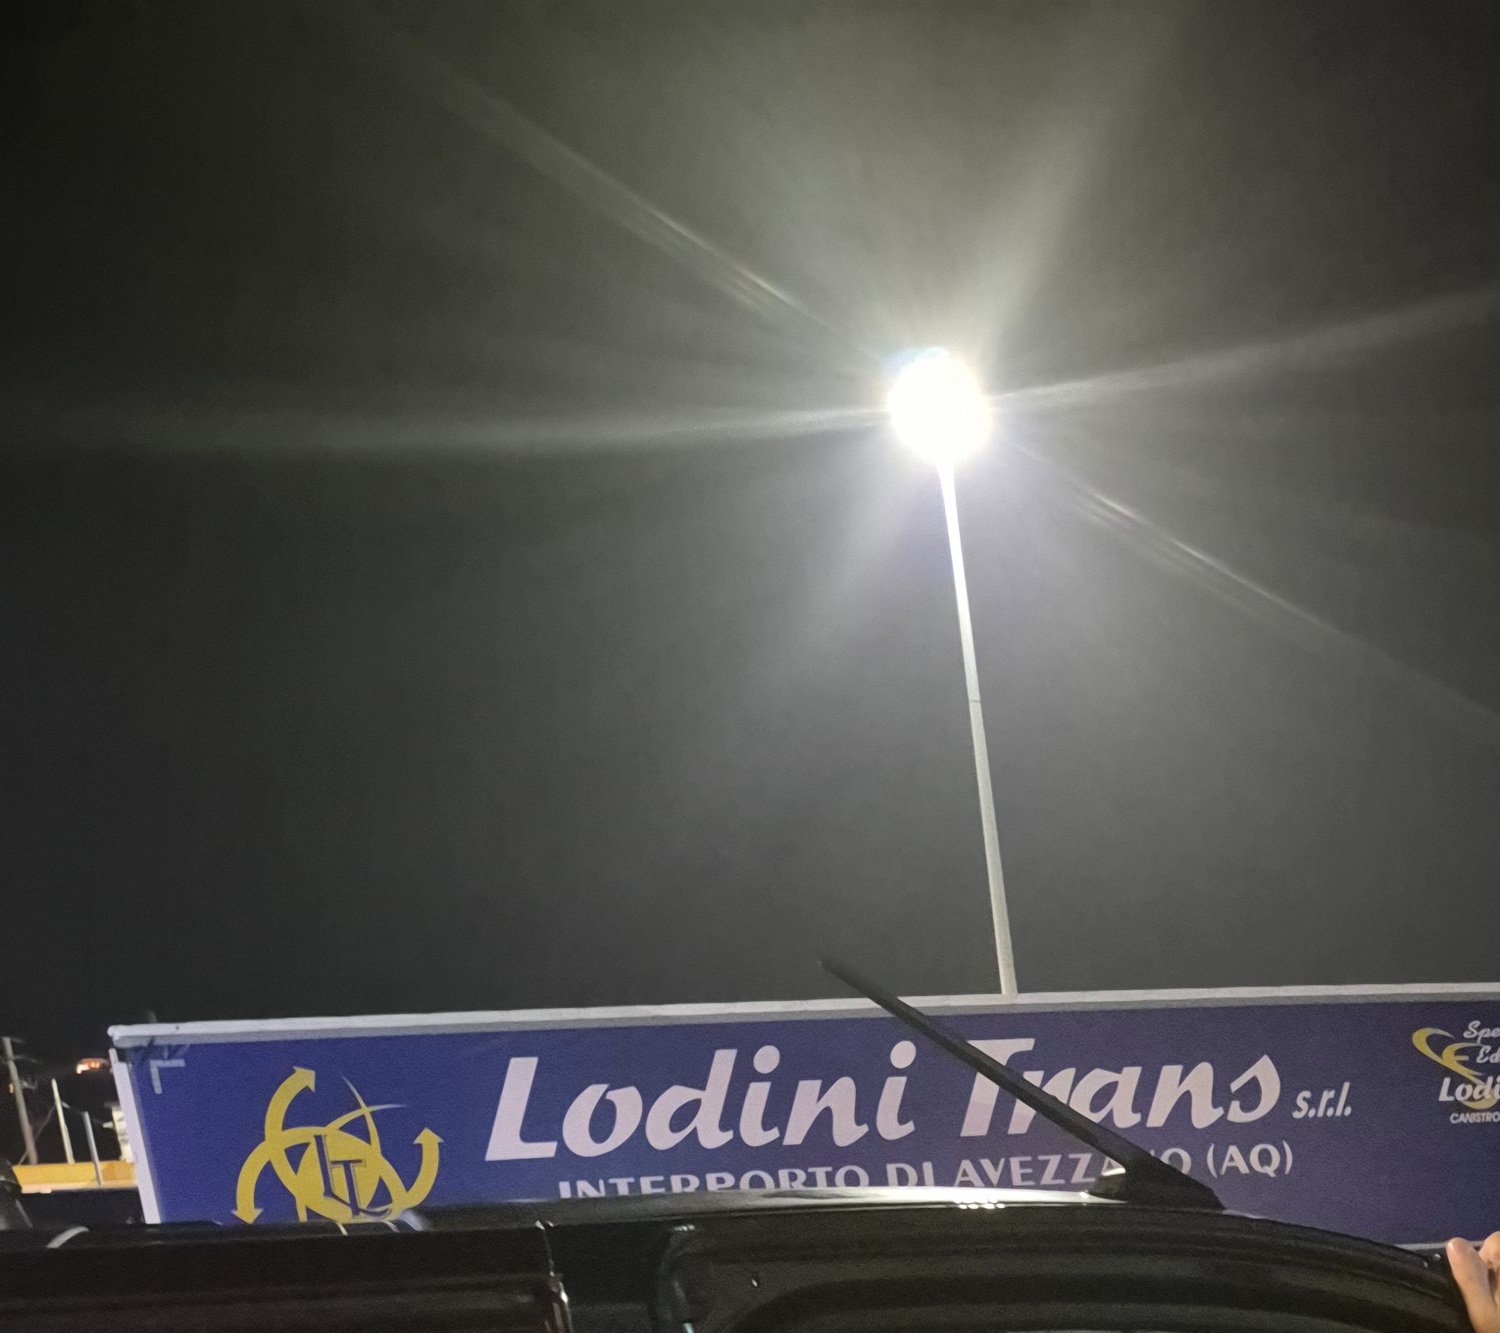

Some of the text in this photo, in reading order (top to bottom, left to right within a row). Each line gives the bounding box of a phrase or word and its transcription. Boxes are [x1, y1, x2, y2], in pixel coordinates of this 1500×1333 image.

[484, 1038, 1352, 1162] Lodini Trans s.r.l.
[1450, 1112, 1500, 1124] CANISTRO
[886, 1161, 935, 1187] DI
[954, 1147, 1192, 1188] AVEZZO
[1207, 1141, 1293, 1178] (AQ)
